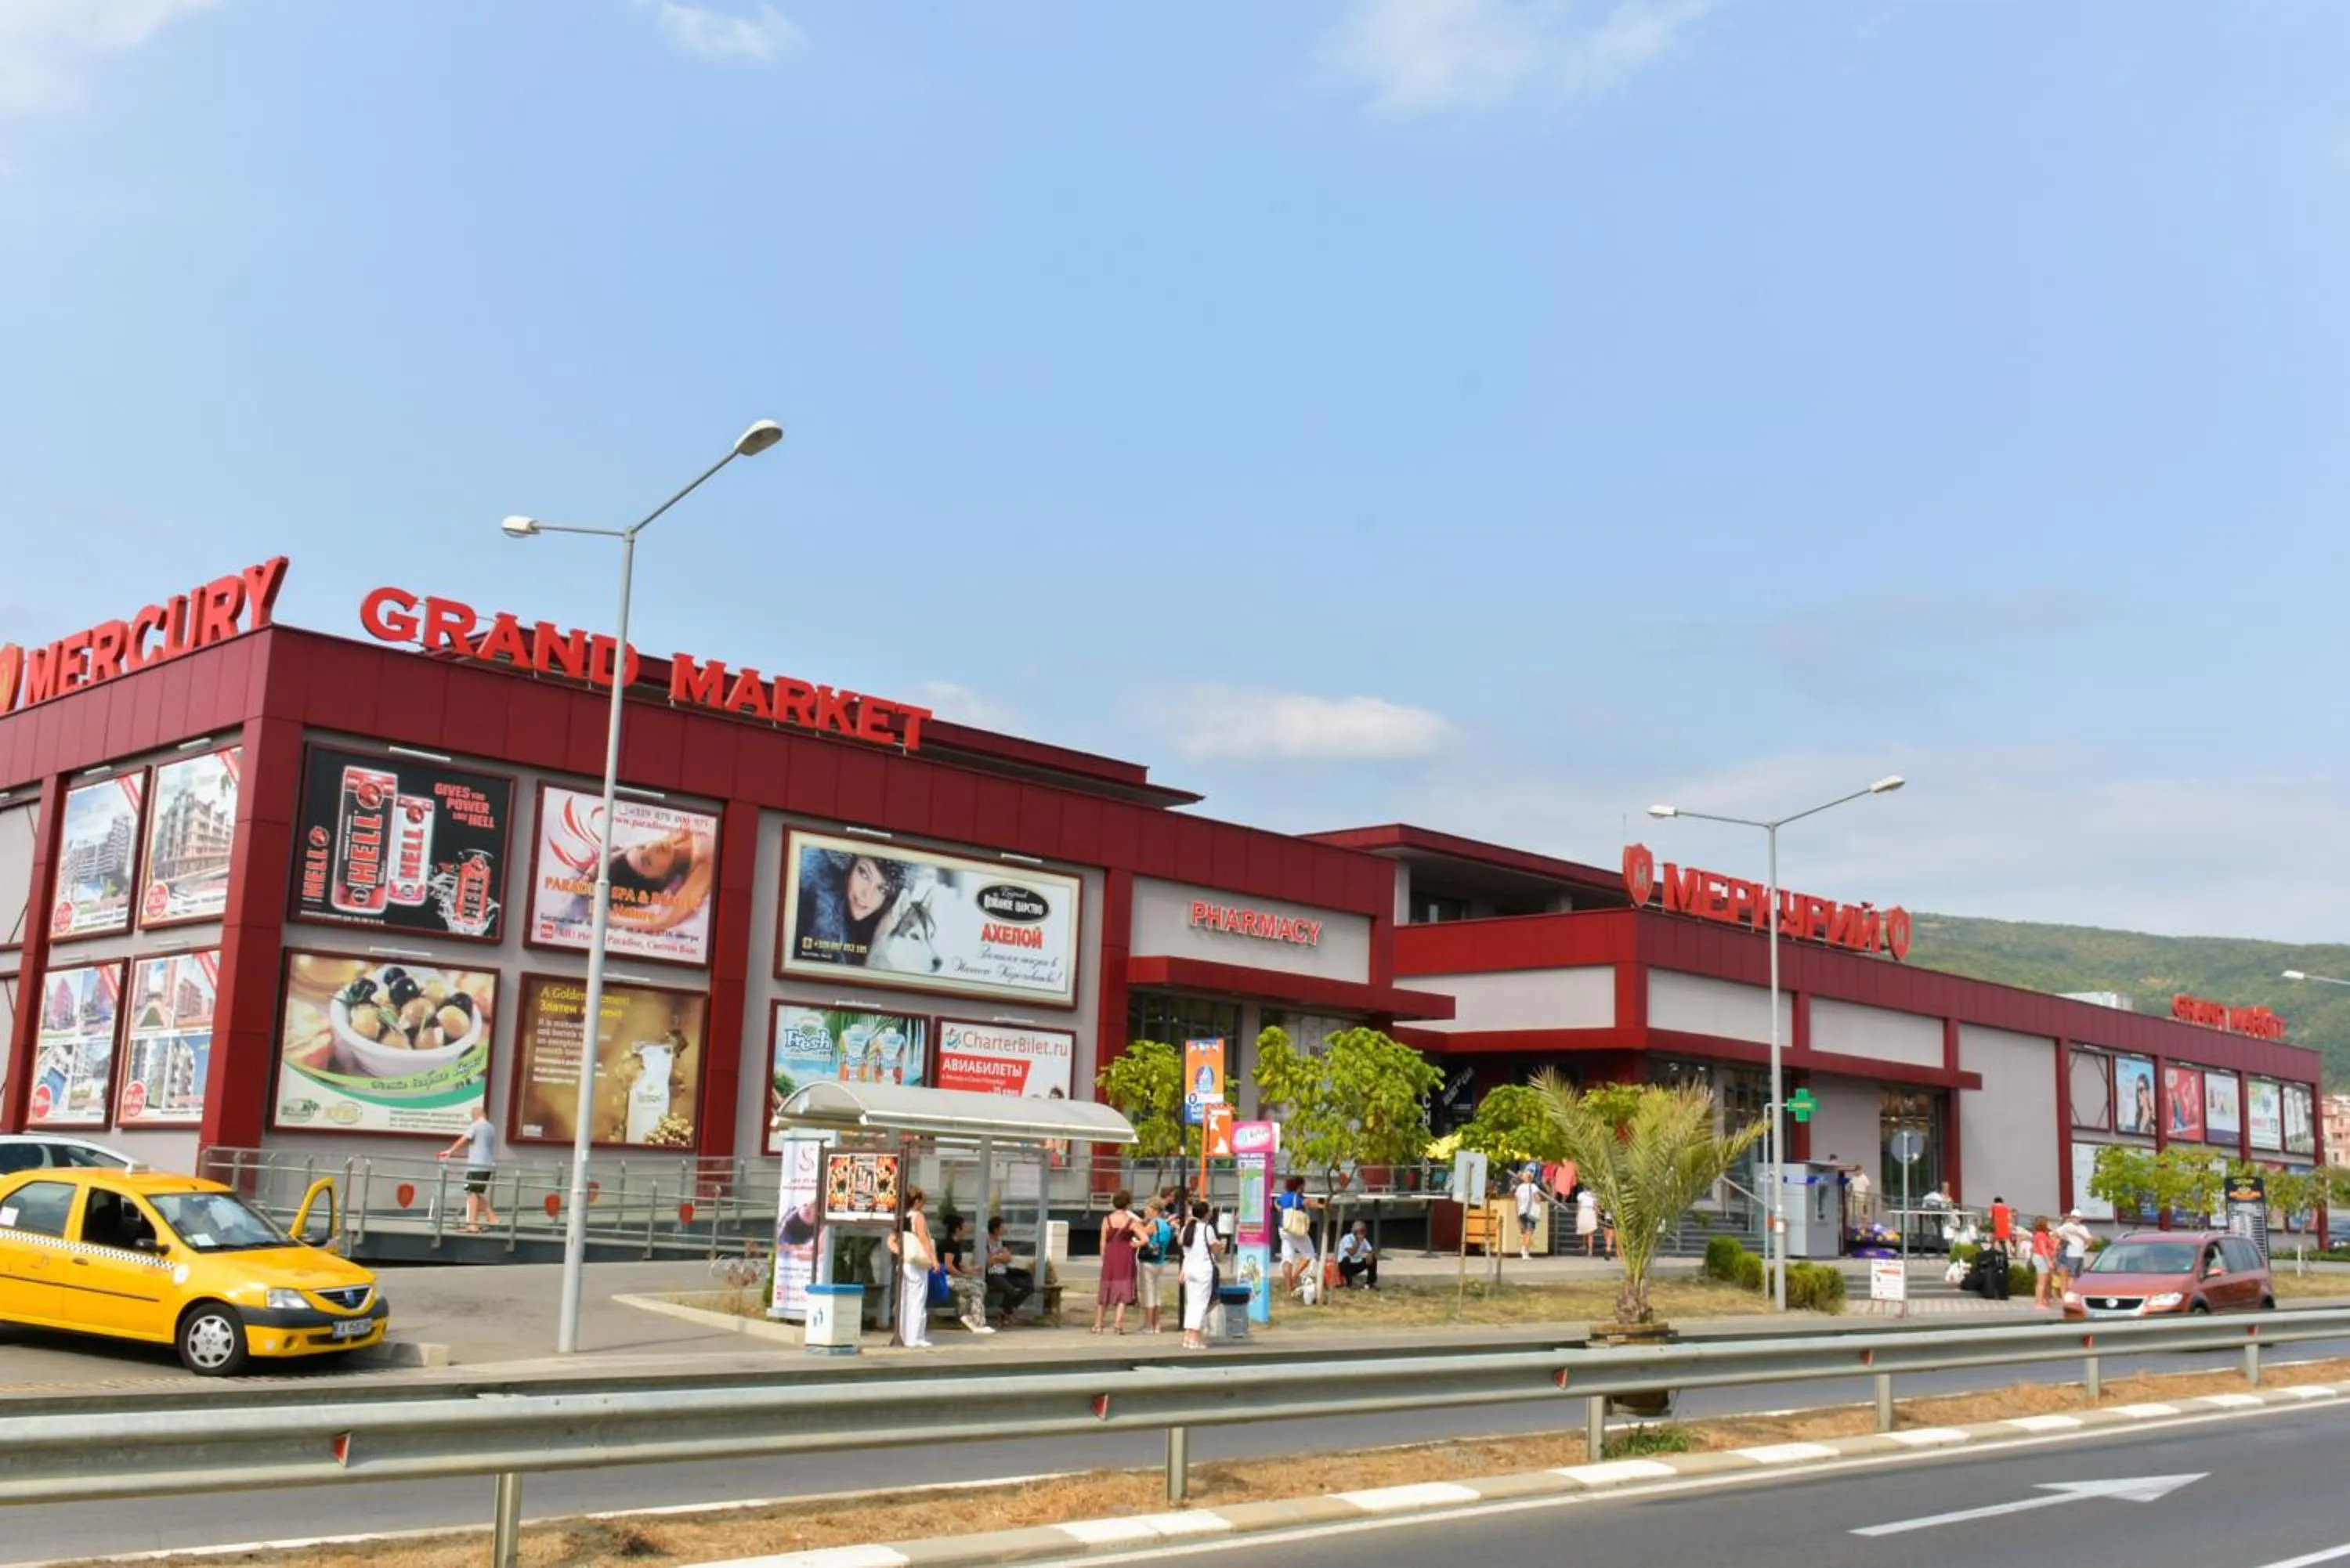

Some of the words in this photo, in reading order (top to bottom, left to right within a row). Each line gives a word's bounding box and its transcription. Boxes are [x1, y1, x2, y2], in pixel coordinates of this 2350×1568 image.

[24, 555, 289, 704] MERCURY
[360, 586, 638, 688] GRAND
[669, 652, 932, 750] MARKET
[302, 848, 329, 898] HELL
[347, 814, 383, 885] HELL
[400, 828, 425, 880] HELL
[1191, 901, 1322, 946] PHARMACY
[1662, 862, 1882, 952] МЕРКУРИЙ
[784, 1026, 833, 1052] Fresh
[963, 1031, 1068, 1057] CharterBilet.ru
[942, 1058, 1023, 1077] АВИАБИЛЕТЫ
